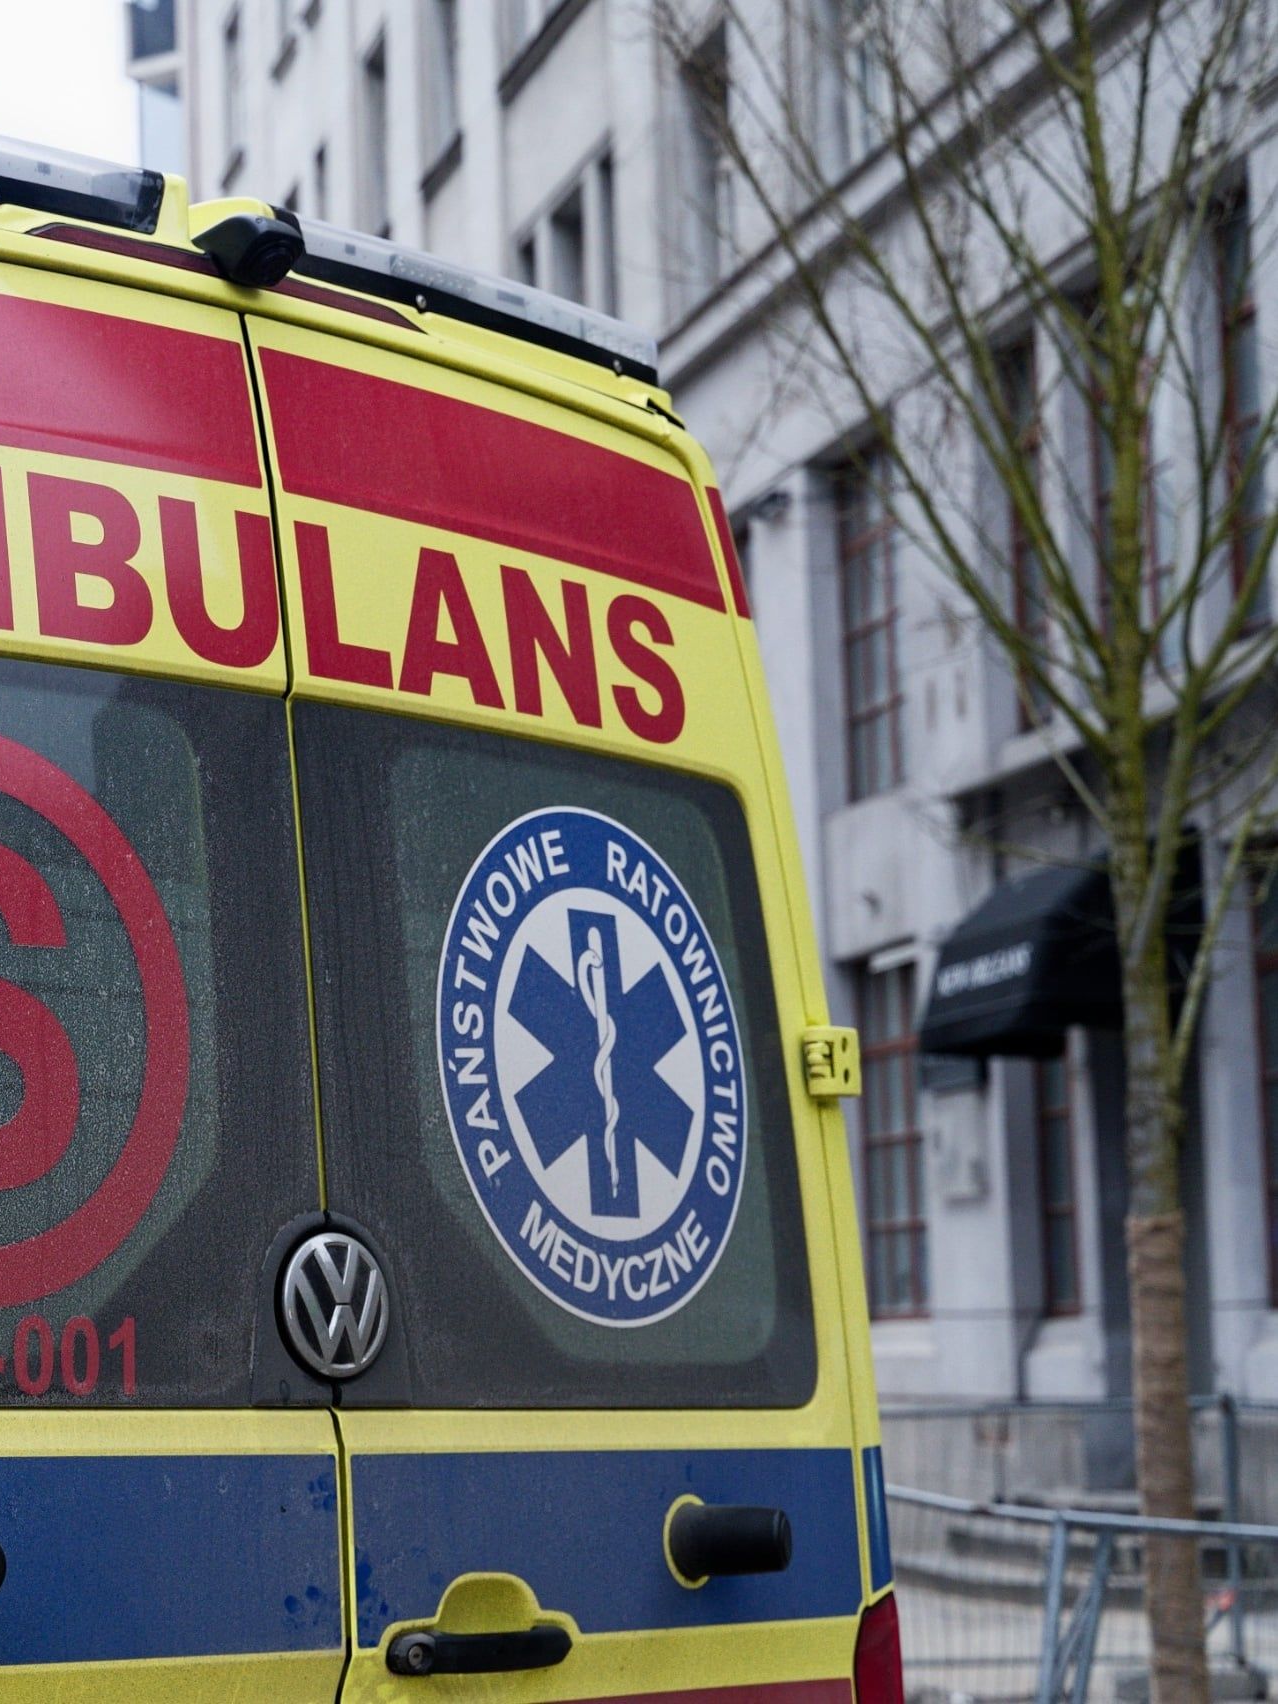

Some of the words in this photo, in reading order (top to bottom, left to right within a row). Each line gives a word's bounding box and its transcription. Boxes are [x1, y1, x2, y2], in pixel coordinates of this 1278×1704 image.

[449, 830, 570, 1182] PAŃSTWOWE
[606, 840, 736, 1196] RATOWNICTWO
[282, 1234, 389, 1376] VW
[519, 1200, 711, 1301] MEDYCZNE
